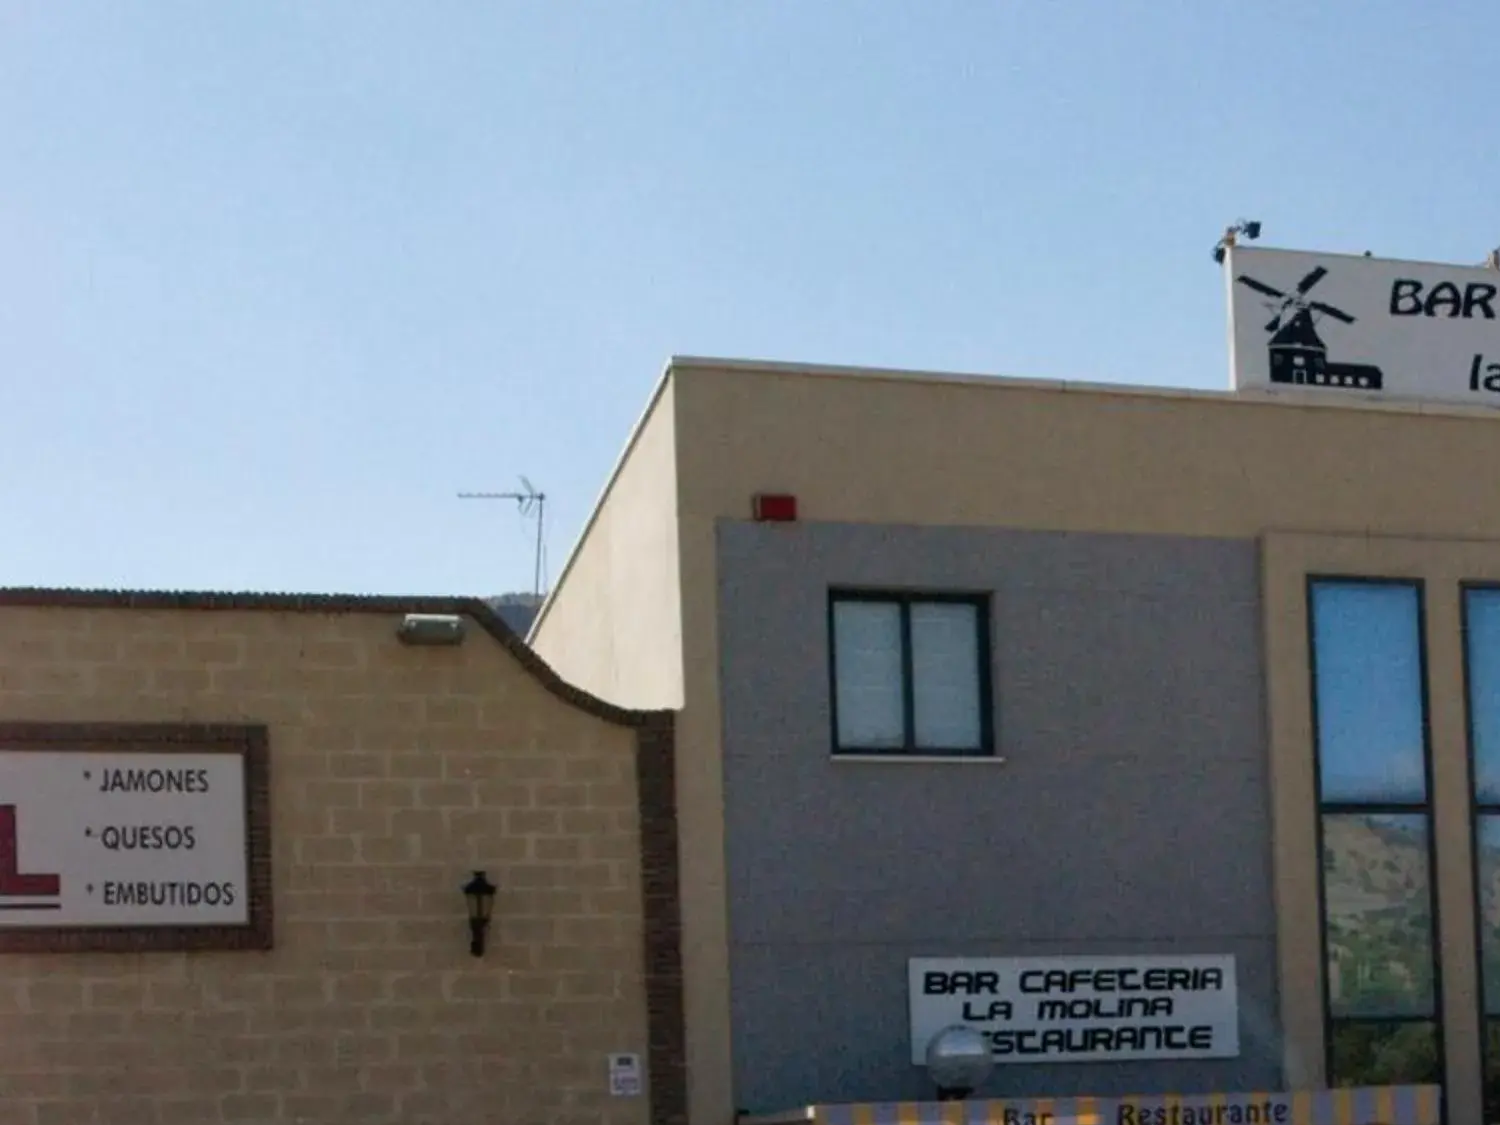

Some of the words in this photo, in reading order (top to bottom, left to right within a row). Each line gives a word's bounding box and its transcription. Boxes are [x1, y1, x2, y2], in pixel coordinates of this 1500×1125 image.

[1389, 279, 1498, 319] BAR
[100, 769, 209, 793] JAMONES
[101, 826, 196, 850] QUESOS
[103, 882, 235, 906] EMBUTIDOS
[923, 971, 1000, 996] BAR
[1019, 967, 1223, 994] CAFETERIA
[962, 1001, 1013, 1022] LA
[982, 1025, 1213, 1055] STAURANTE
